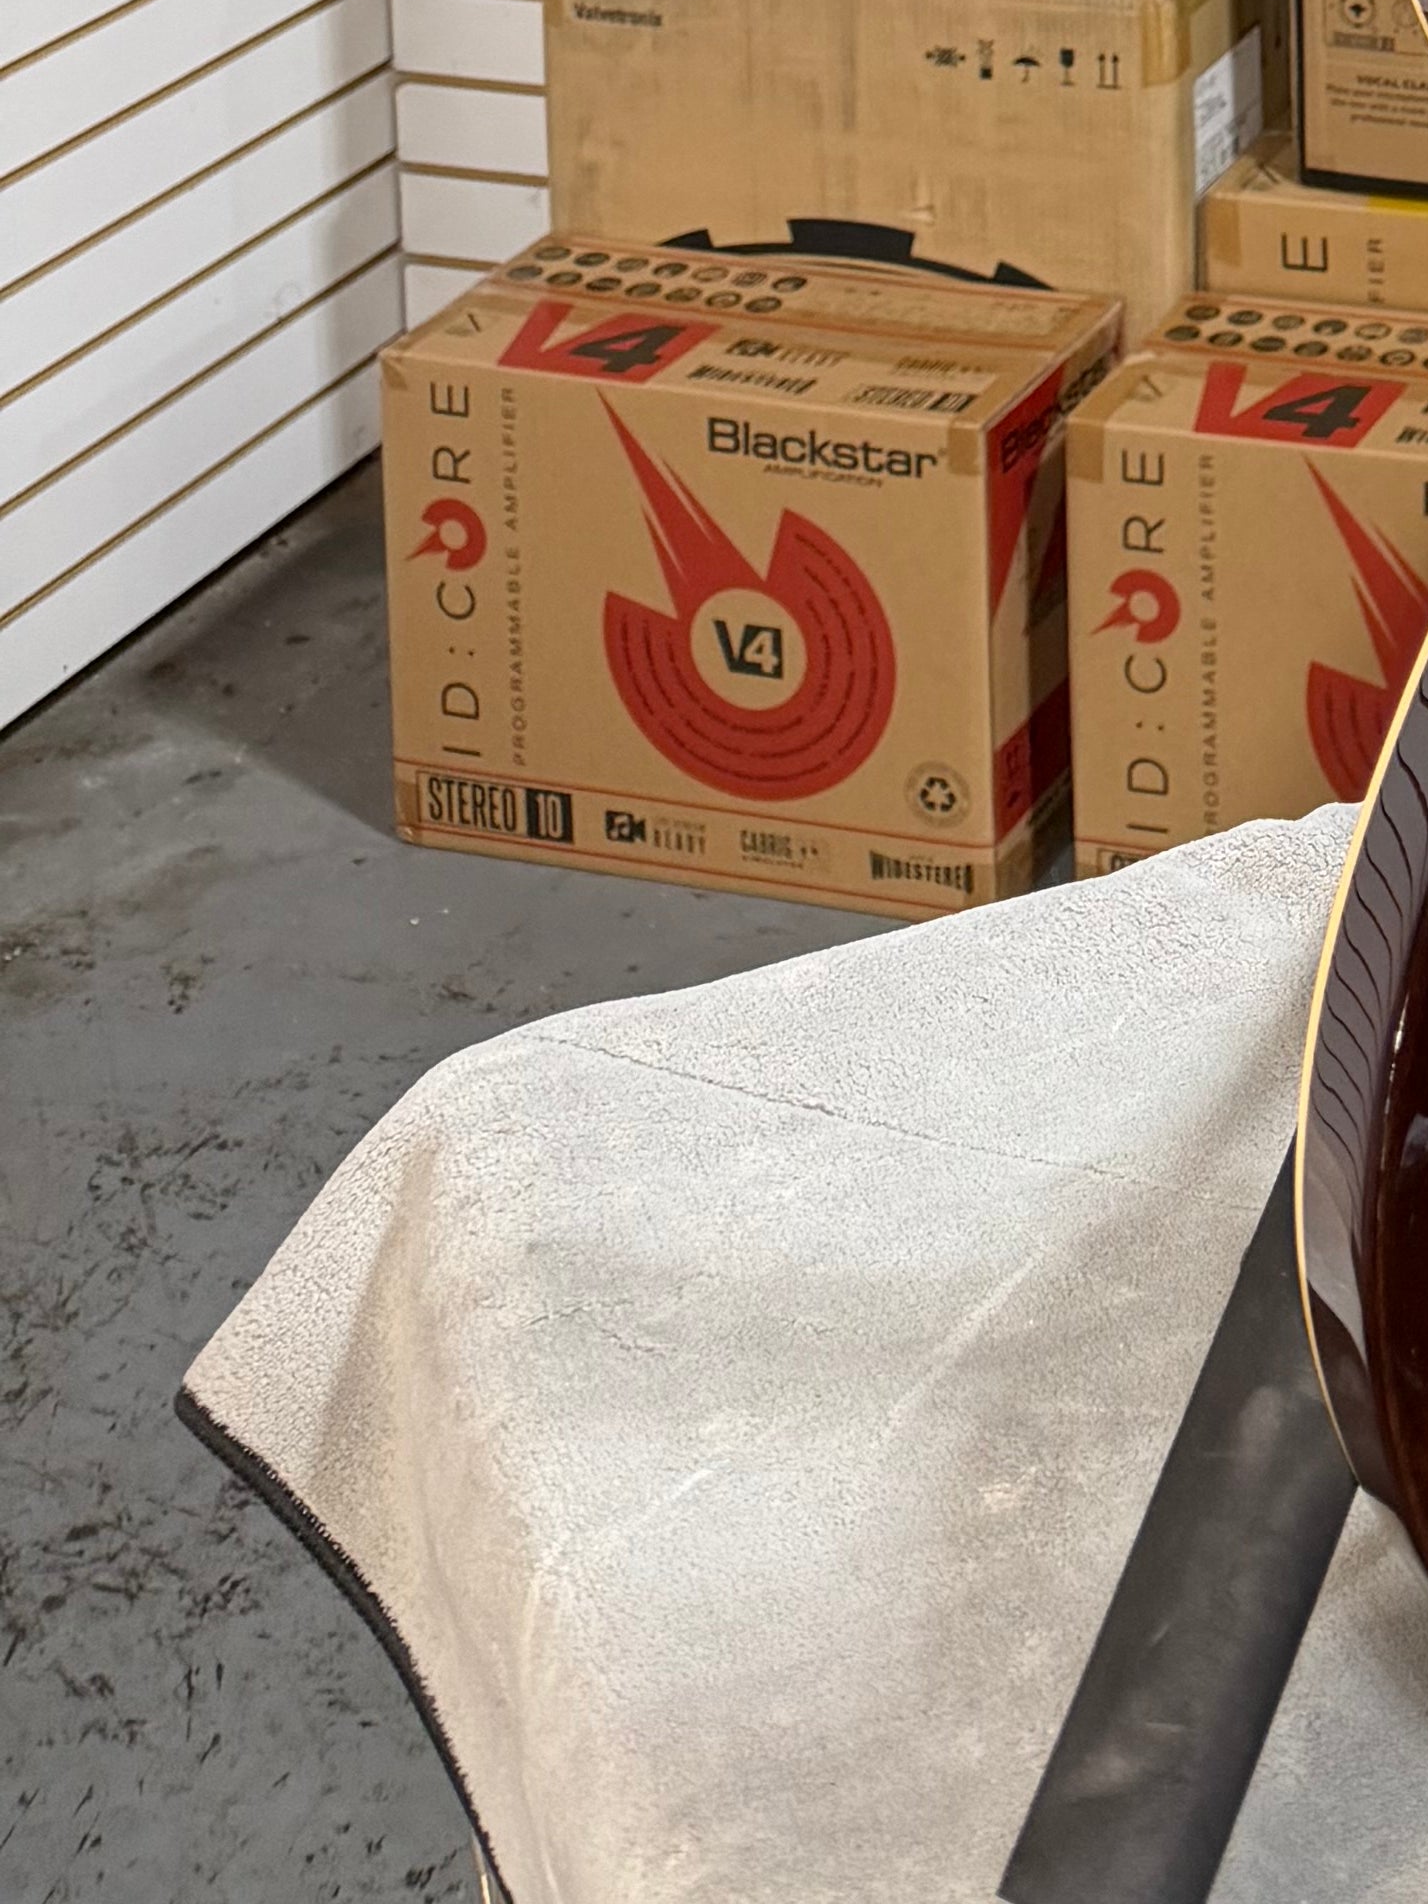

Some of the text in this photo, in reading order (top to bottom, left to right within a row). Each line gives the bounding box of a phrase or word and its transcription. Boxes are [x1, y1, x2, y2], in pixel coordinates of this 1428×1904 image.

[572, 0, 664, 29] Valvetronix
[496, 299, 727, 385] V4
[1195, 362, 1408, 449] V4
[707, 417, 938, 480] Blackstar
[1198, 453, 1217, 602] AMPLIFIER
[501, 385, 526, 766] PROGRAMMABLE AMPLIFIER
[712, 618, 785, 681] V4
[428, 776, 564, 839] STEREO 10
